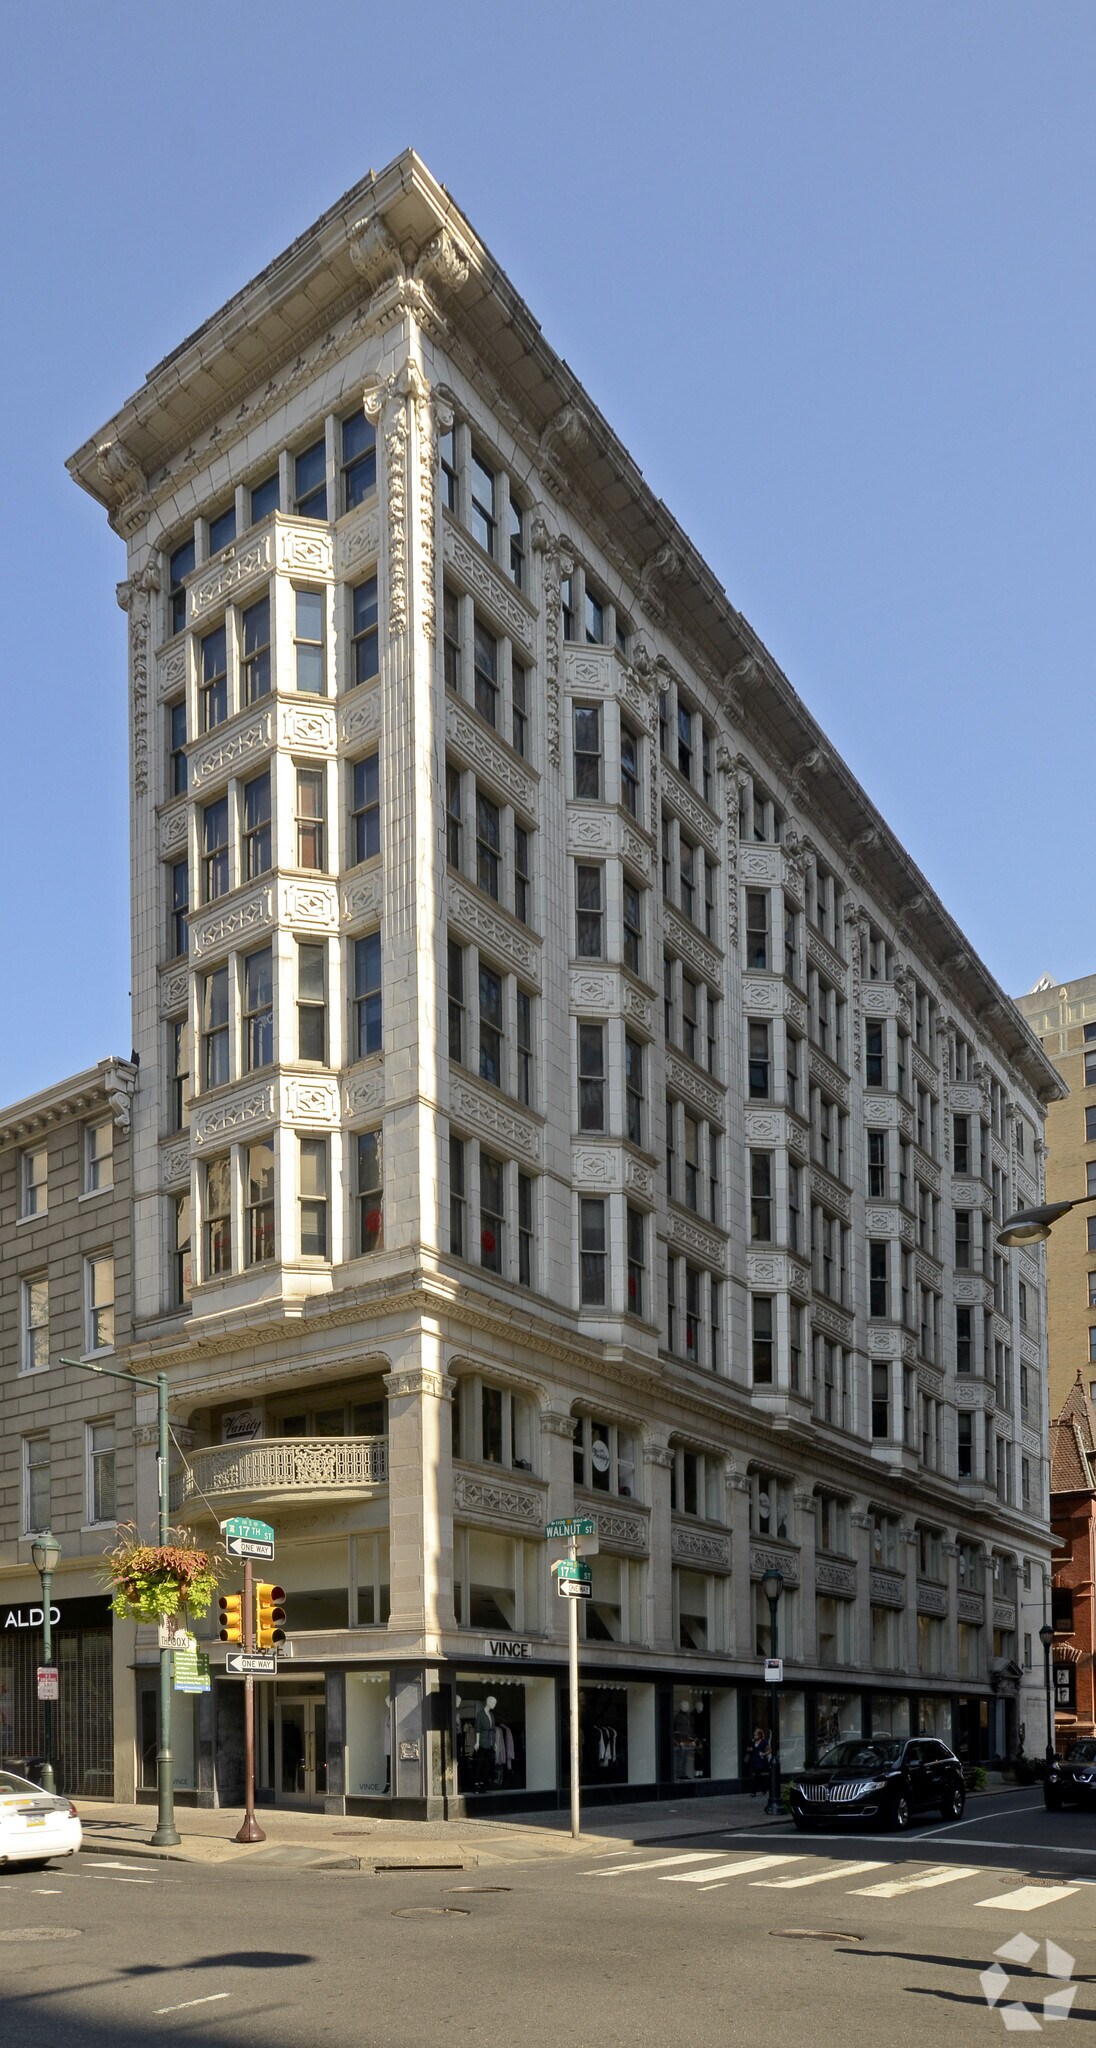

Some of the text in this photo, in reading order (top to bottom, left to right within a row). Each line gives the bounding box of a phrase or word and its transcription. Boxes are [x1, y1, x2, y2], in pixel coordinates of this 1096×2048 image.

[224, 1412, 261, 1440] Vanity
[239, 1525, 271, 1540] 17TH ST
[546, 1524, 592, 1538] WALNUT ST
[241, 1543, 269, 1554] ONE WAY
[584, 1572, 591, 1580] ST
[569, 1584, 578, 1592] ONE
[172, 1637, 187, 1647] BOX
[241, 1660, 256, 1668] ONE
